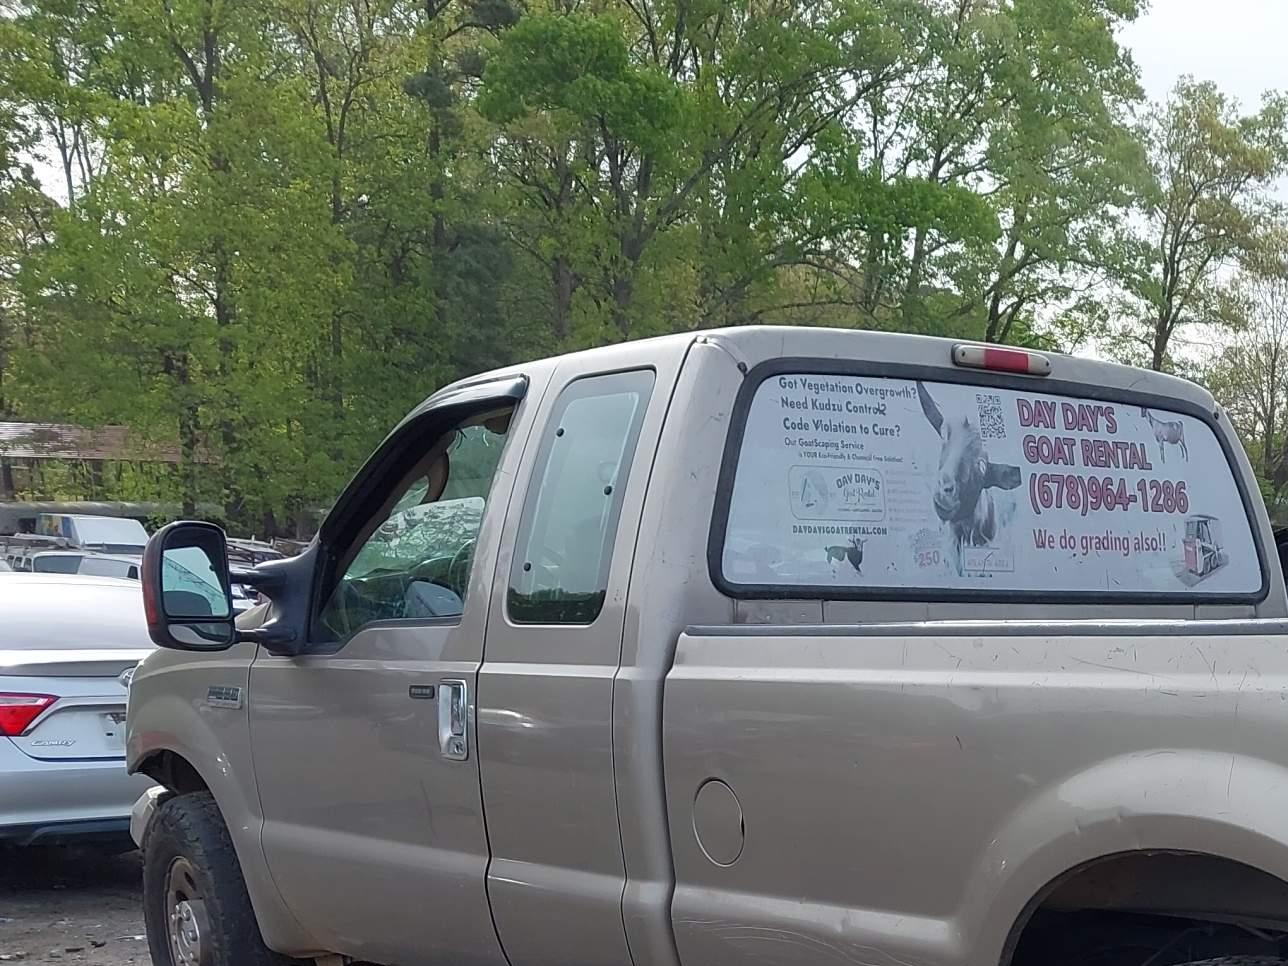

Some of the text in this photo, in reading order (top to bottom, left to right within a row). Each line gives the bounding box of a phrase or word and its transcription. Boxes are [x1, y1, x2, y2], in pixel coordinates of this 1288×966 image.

[779, 376, 917, 400] Got Vegetation Overgrowth?
[781, 396, 808, 410] Need
[811, 397, 843, 413] Kudzu
[1016, 398, 1118, 434] DAY DAY'S
[783, 417, 901, 438] Code Violation to Cure?
[784, 437, 797, 447] Our
[840, 440, 865, 451] Service
[1022, 434, 1153, 471] GOAT RENTAL
[836, 473, 853, 489] DAY
[854, 473, 880, 491] DAY'S
[1029, 473, 1189, 516] (678)964-1286
[1033, 528, 1167, 557] We do grading also!!
